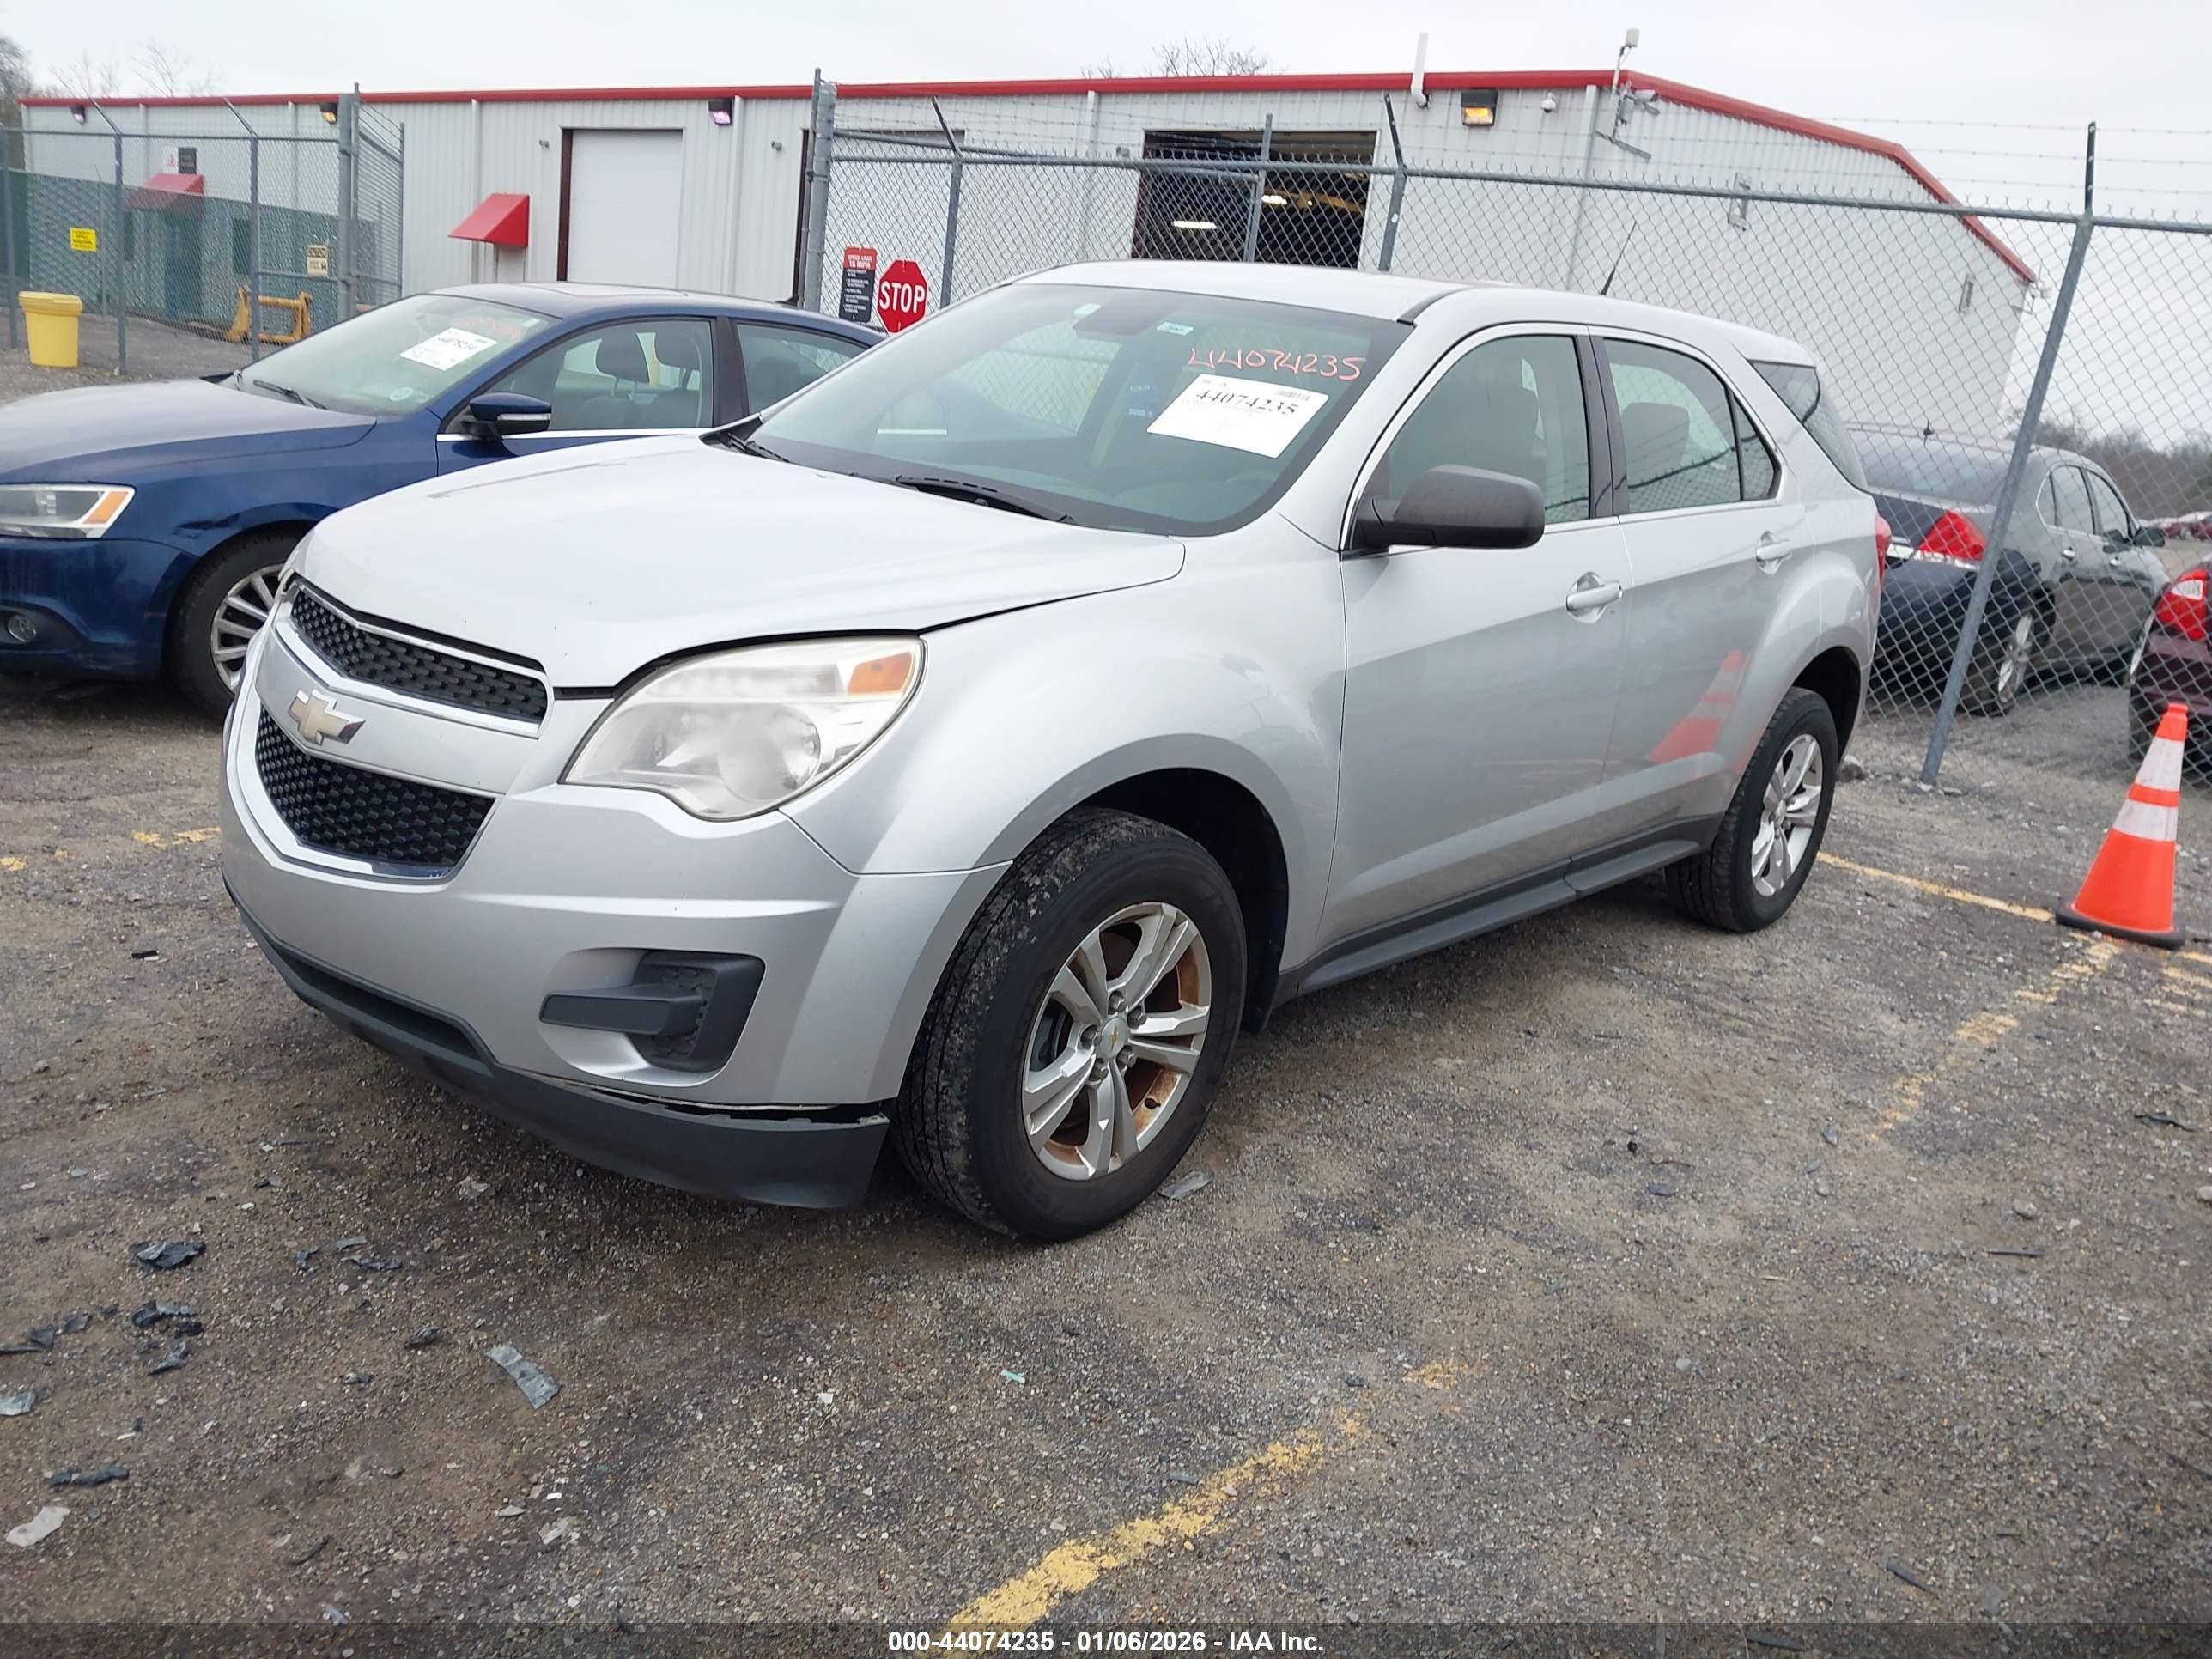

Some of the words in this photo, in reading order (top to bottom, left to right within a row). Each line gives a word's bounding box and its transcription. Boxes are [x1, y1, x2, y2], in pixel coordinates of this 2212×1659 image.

[879, 281, 925, 313] STOP
[1188, 347, 1367, 380] 44074235
[1195, 388, 1299, 416] 44074235
